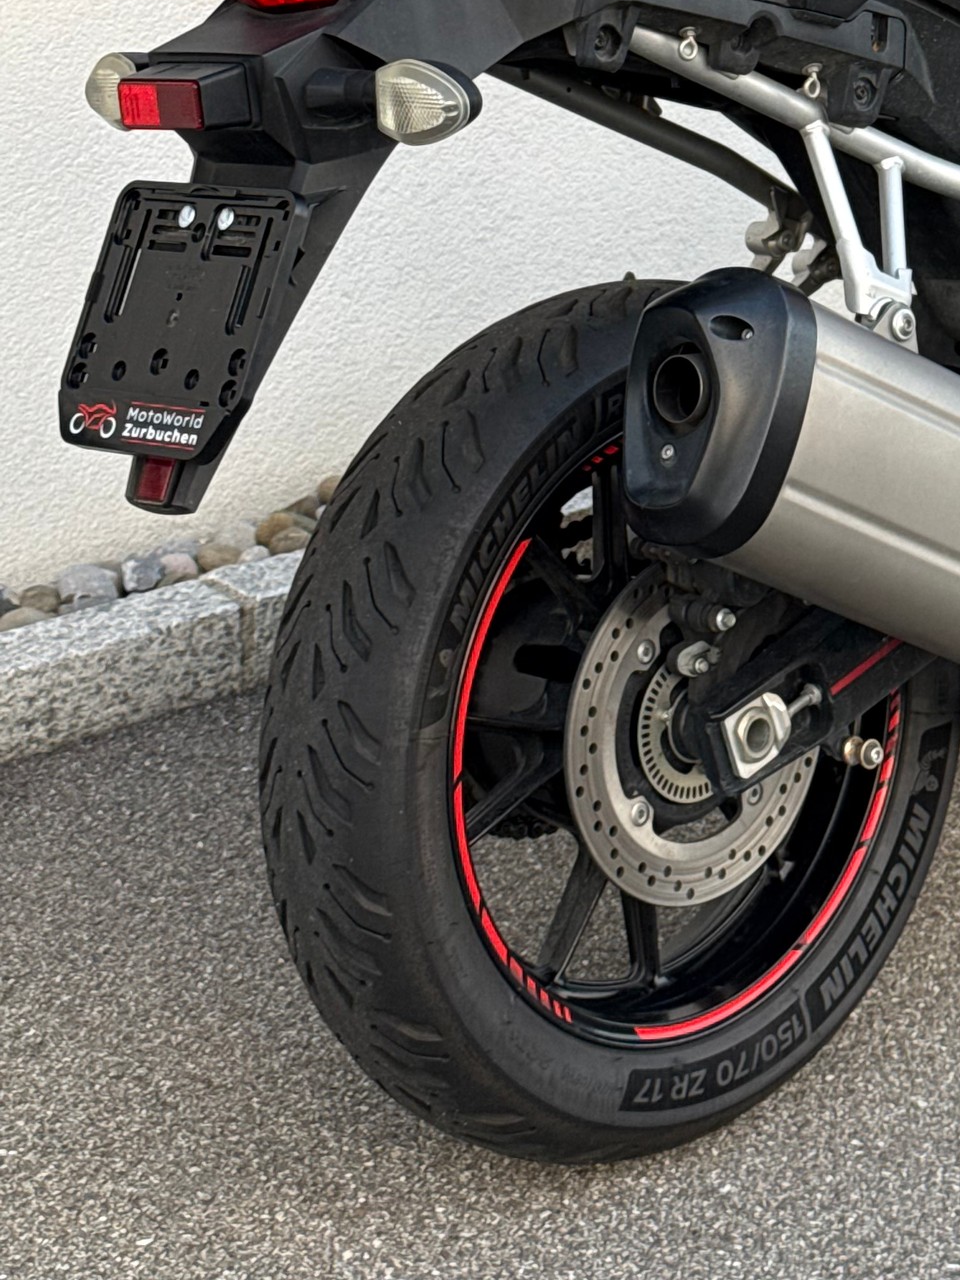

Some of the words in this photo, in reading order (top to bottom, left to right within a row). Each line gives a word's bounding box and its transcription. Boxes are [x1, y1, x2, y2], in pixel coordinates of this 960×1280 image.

[126, 407, 204, 429] MotoWorld
[122, 423, 198, 445] Zurbuchen
[452, 419, 584, 634] MICHELIN
[819, 803, 931, 1010] MICHELIN
[716, 1014, 804, 1086] 150/70
[634, 1077, 664, 1103] 17
[671, 1069, 707, 1100] ZR
